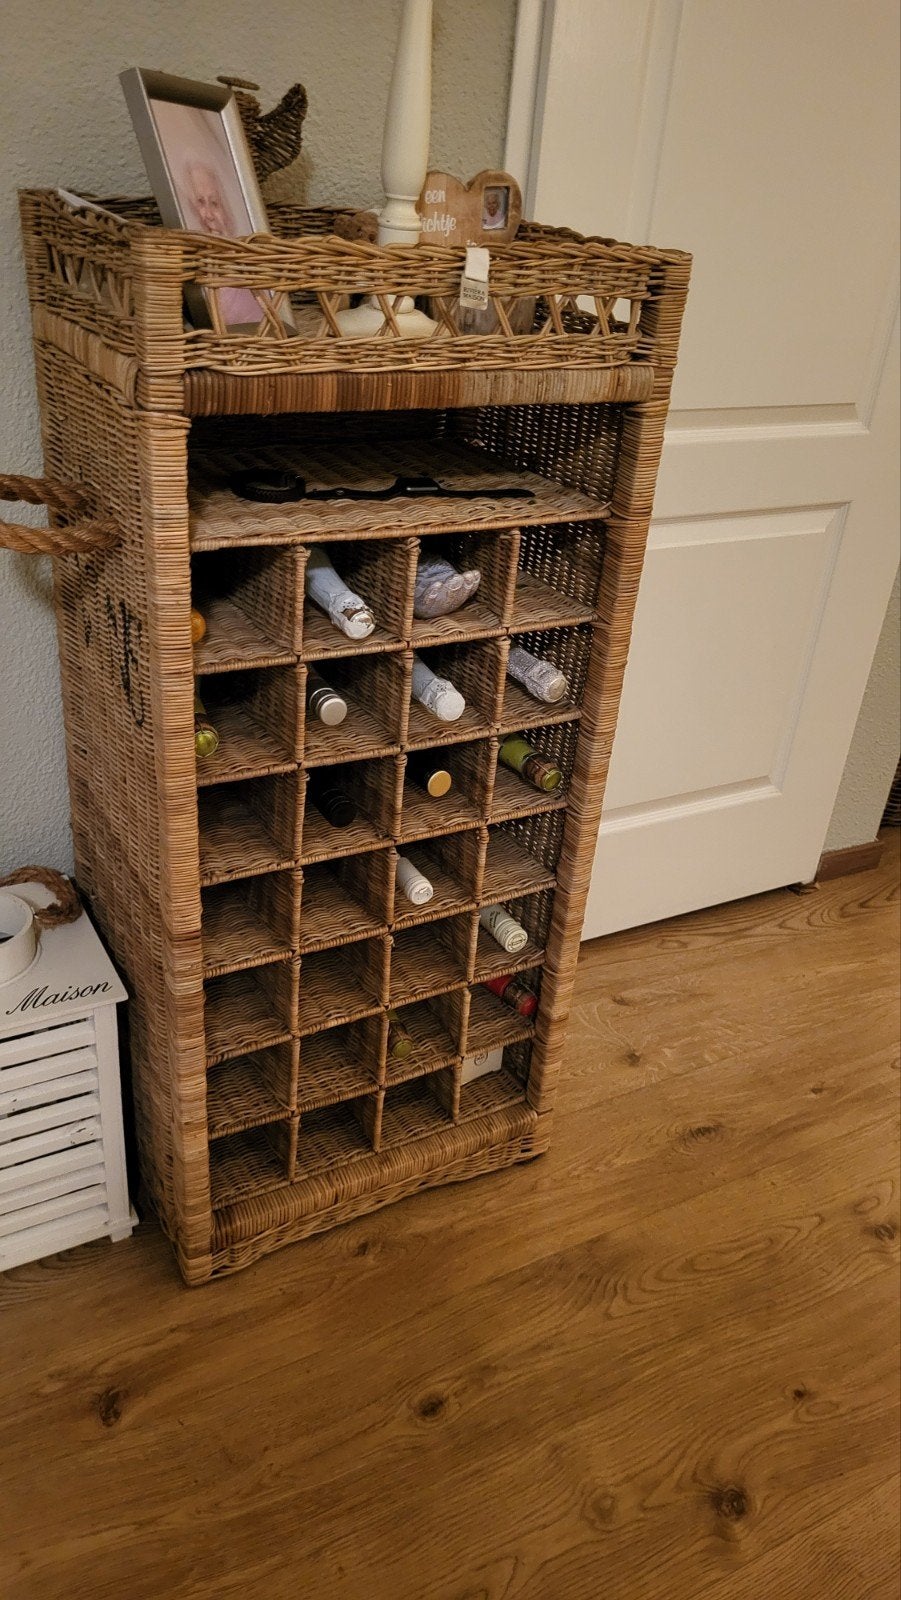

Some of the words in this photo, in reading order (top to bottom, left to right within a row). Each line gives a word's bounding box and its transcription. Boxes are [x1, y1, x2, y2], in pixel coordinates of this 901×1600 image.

[425, 189, 446, 204] een
[421, 211, 457, 237] ichtje
[5, 981, 114, 1015] Maison
